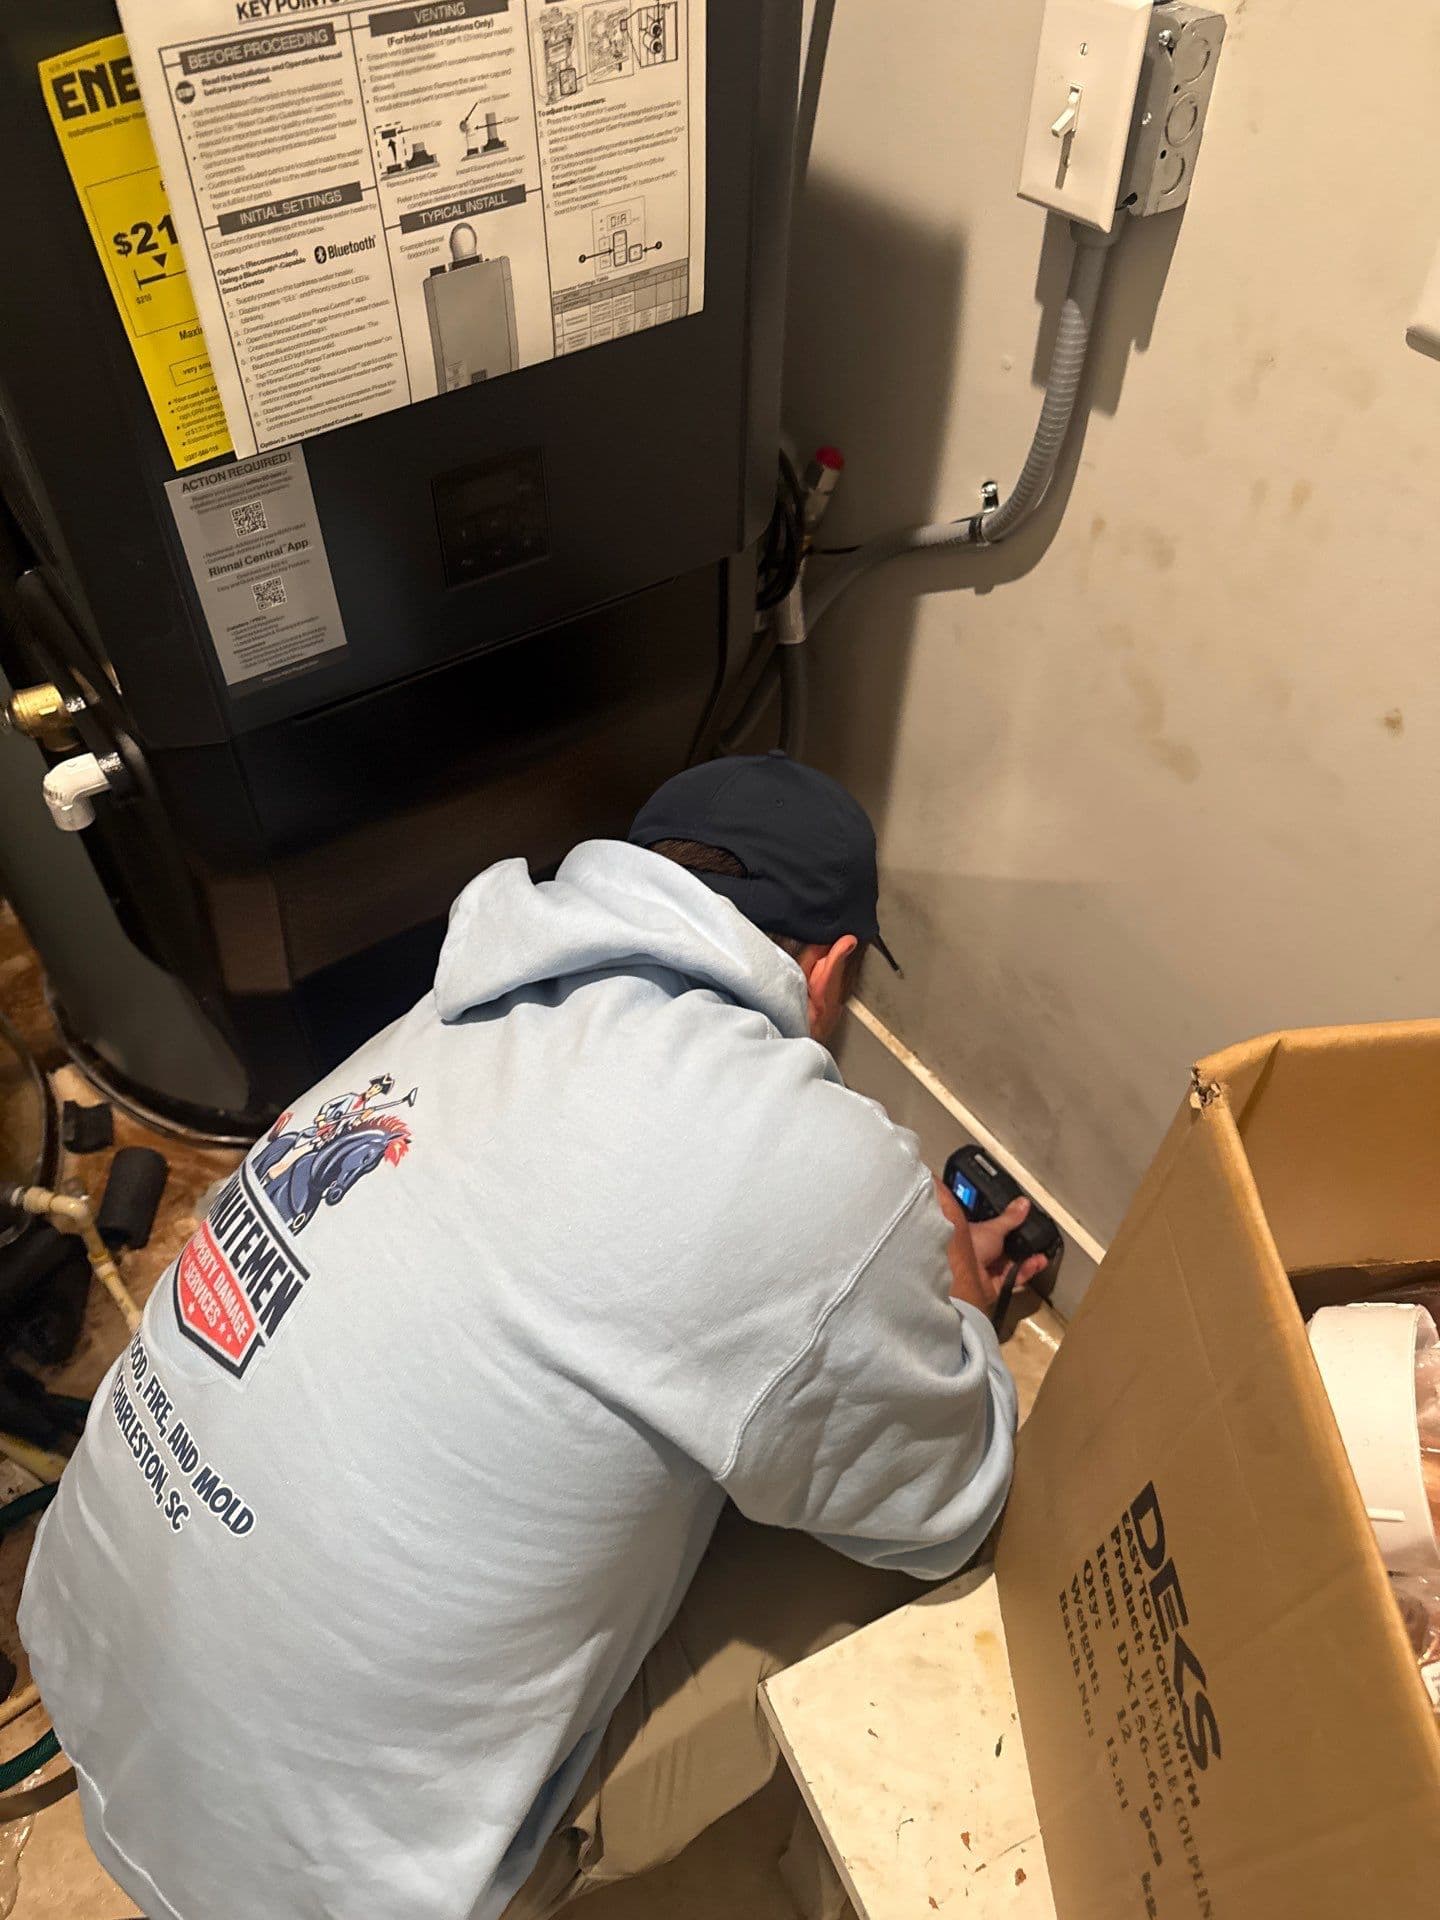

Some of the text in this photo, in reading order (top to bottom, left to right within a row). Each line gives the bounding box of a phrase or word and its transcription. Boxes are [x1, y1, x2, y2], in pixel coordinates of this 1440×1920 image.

[236, 0, 269, 20] KEY
[387, 17, 493, 47] (For Indoor Installations Only)
[414, 1, 465, 24] VENTING
[188, 29, 328, 68] BEFORE PROCEEDING
[240, 190, 341, 224] INITIAL SETTINGS
[420, 192, 507, 225] TYPICAL INSTALL
[179, 327, 203, 340] Maxi
[182, 471, 226, 493] ACTION
[228, 452, 291, 480] REQUIRED!
[208, 561, 243, 578] Rinnai
[287, 538, 309, 555] App
[208, 1172, 304, 1339] NUTEMEN
[184, 1264, 221, 1328] SERVICES
[214, 1273, 250, 1344] DAMAGE
[113, 1375, 190, 1531] CHARLESTON, SC
[143, 1376, 174, 1438] FIRE,
[167, 1422, 198, 1474] AND
[191, 1466, 255, 1535] MOLD
[1096, 1541, 1120, 1630] Item:
[1071, 1572, 1100, 1695] Weight:
[1110, 1524, 1145, 1656] Product:
[1141, 1669, 1179, 1793] FLEXIBLE
[1122, 1510, 1200, 1808] EASY TO WORK WITH
[1130, 1480, 1221, 1770] DEKS
[1058, 1588, 1096, 1739] Batch No:
[1083, 1559, 1163, 1867] Qty: 12 pcs
